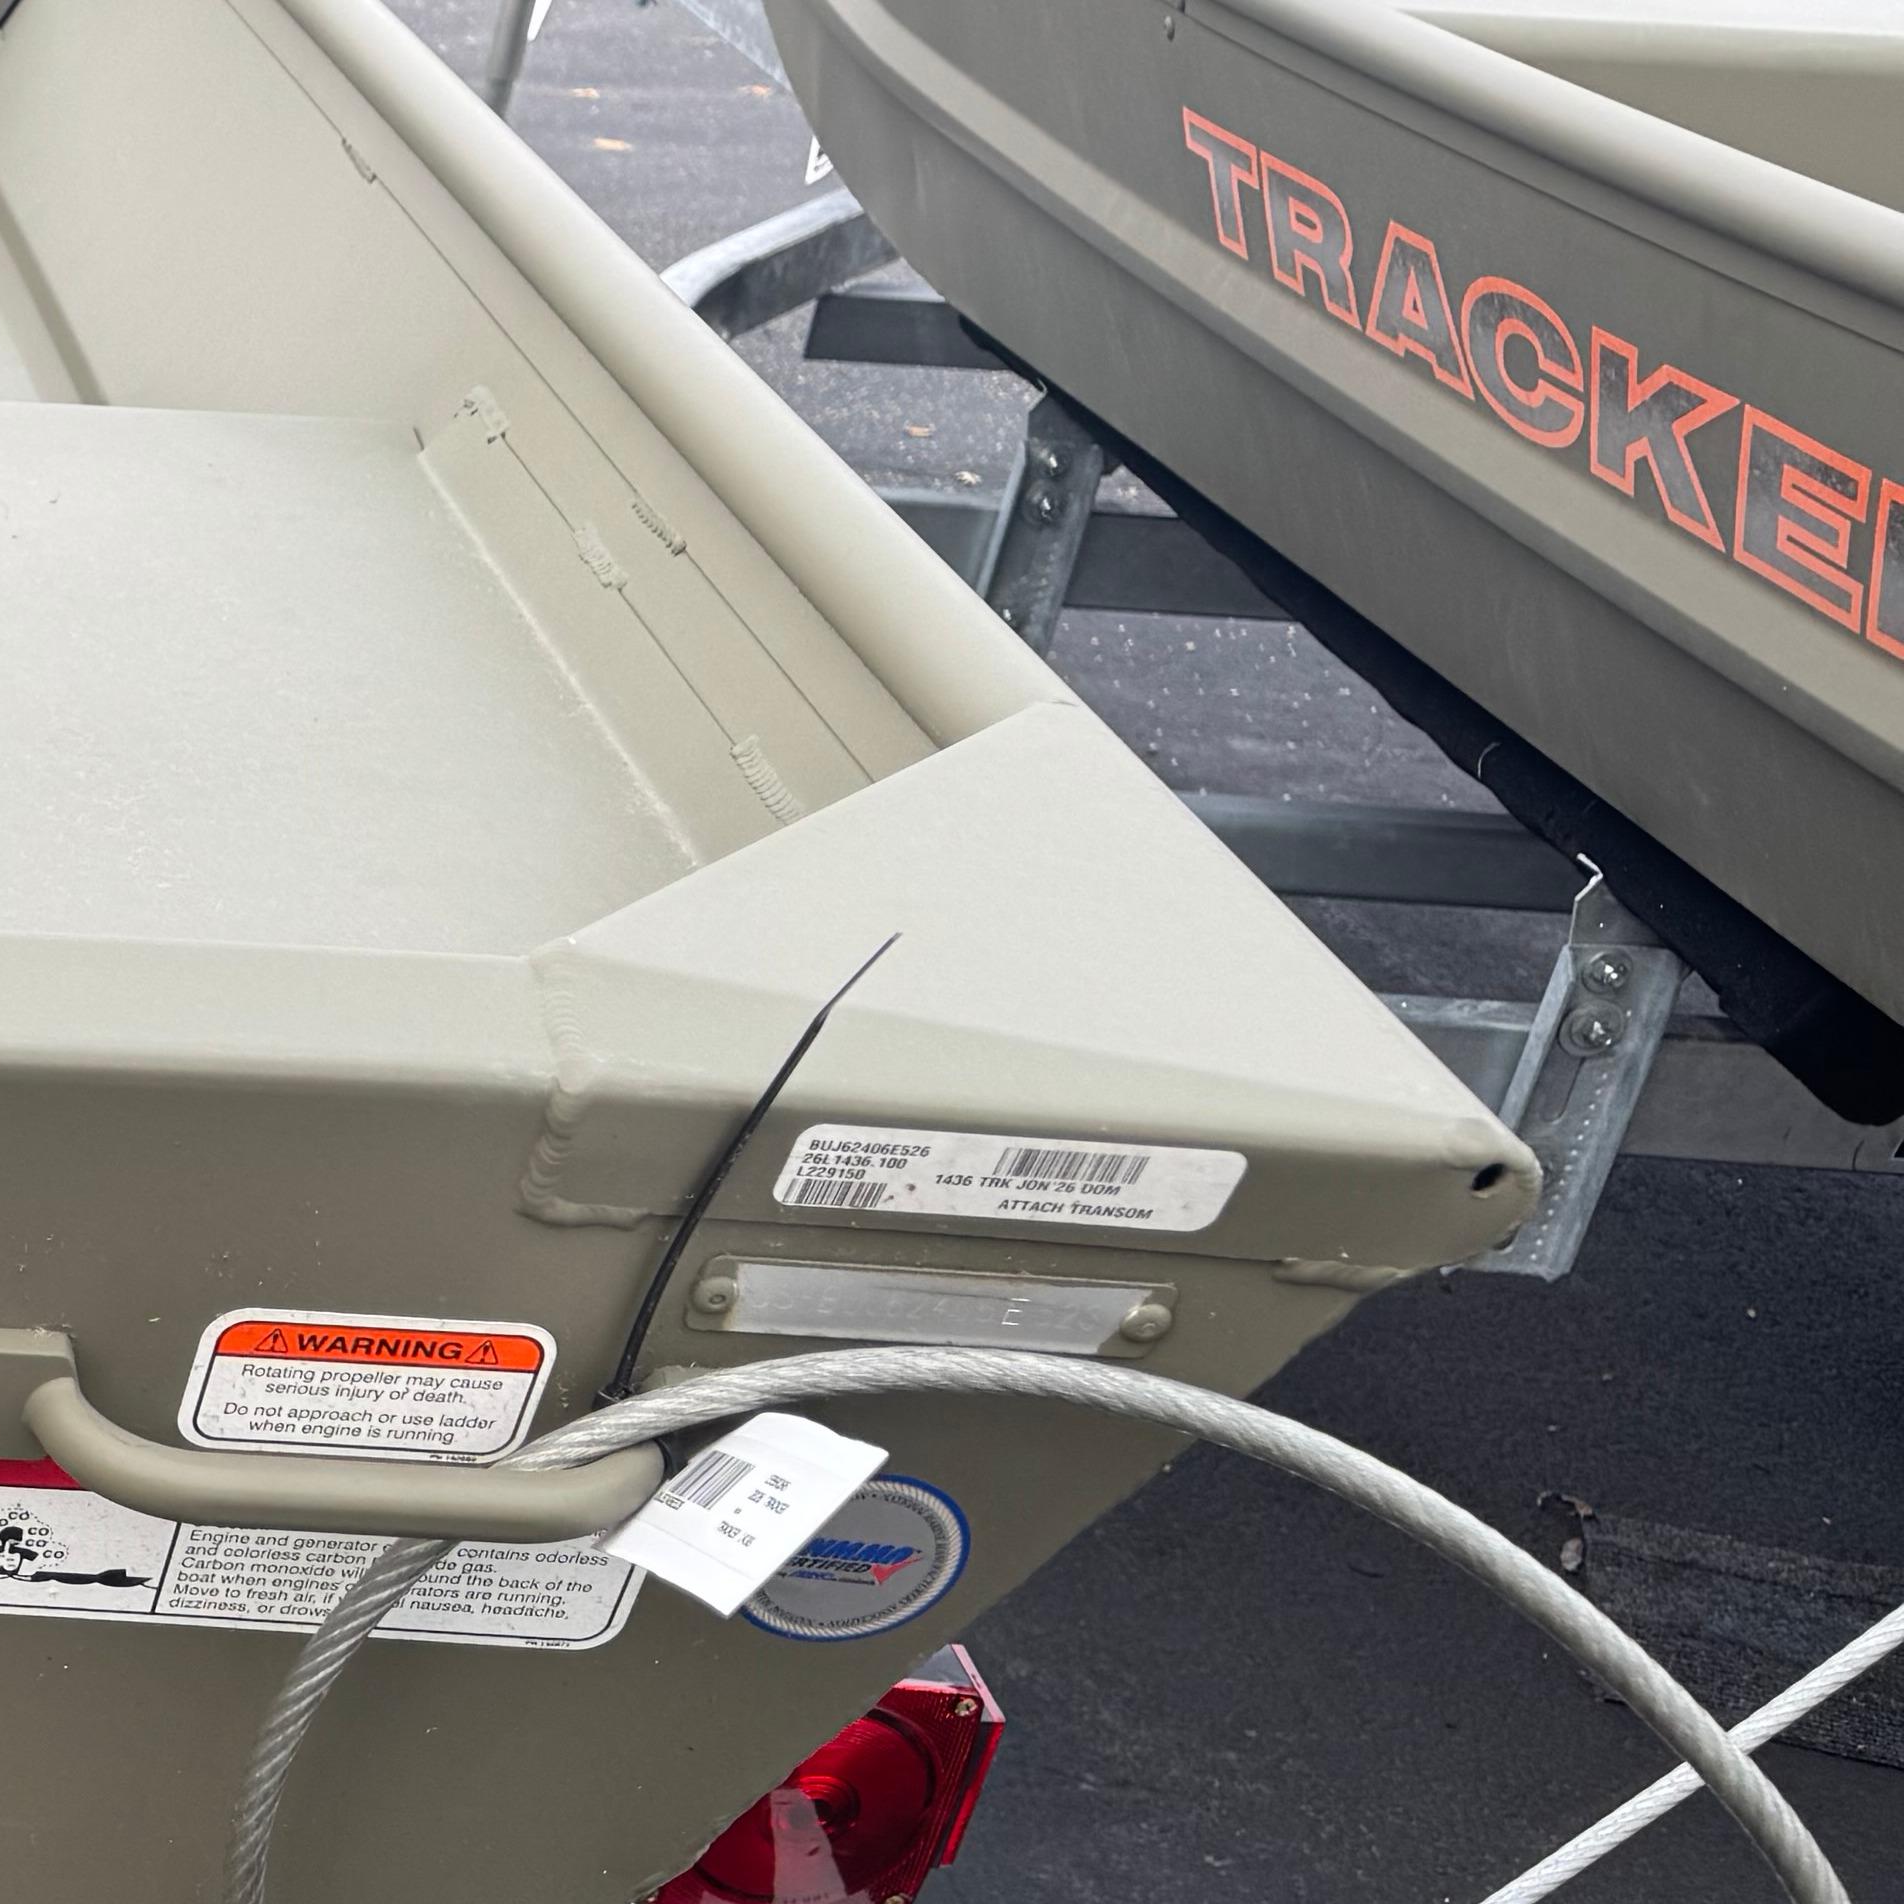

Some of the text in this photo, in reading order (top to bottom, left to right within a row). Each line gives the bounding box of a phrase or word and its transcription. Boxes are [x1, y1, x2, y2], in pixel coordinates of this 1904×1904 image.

[935, 1174, 974, 1187] 1436
[980, 1176, 1011, 1189] TRK
[1016, 1179, 1049, 1192] JON
[998, 1199, 1154, 1220] ATTACH TRANSOM
[297, 1332, 465, 1360] WARNING
[242, 1363, 504, 1391] Rotating propeller may cause
[265, 1381, 468, 1405] serious injury or death.
[223, 1402, 497, 1430] Do not approach or use ladder
[249, 1419, 296, 1433] when
[301, 1424, 362, 1438] engine
[367, 1426, 381, 1439] is
[8, 1510, 30, 1521] CO
[25, 1538, 47, 1548] CO
[27, 1526, 50, 1536] CO
[42, 1549, 65, 1559] CO
[185, 1545, 219, 1556] and
[223, 1547, 301, 1562] colorless
[306, 1553, 366, 1565] carbon
[462, 1562, 497, 1574] gas.
[190, 1529, 250, 1545] Engine
[255, 1536, 289, 1546] and
[293, 1537, 378, 1551] generator
[457, 1548, 530, 1562] contains
[535, 1551, 610, 1567] odorless
[181, 1557, 592, 1593] Carbon monoxide wil ound the back of the
[177, 1571, 216, 1583] boat
[221, 1574, 266, 1587] when
[272, 1578, 339, 1592] engines
[411, 1587, 460, 1599] rators
[464, 1590, 492, 1601] are
[497, 1592, 566, 1608] running.
[168, 1597, 250, 1614] dizziness,
[257, 1604, 275, 1614] or
[173, 1584, 220, 1597] Move
[225, 1587, 241, 1598] to
[246, 1588, 288, 1602] fresh
[410, 1600, 475, 1615] nausea,
[480, 1603, 569, 1620] headache,
